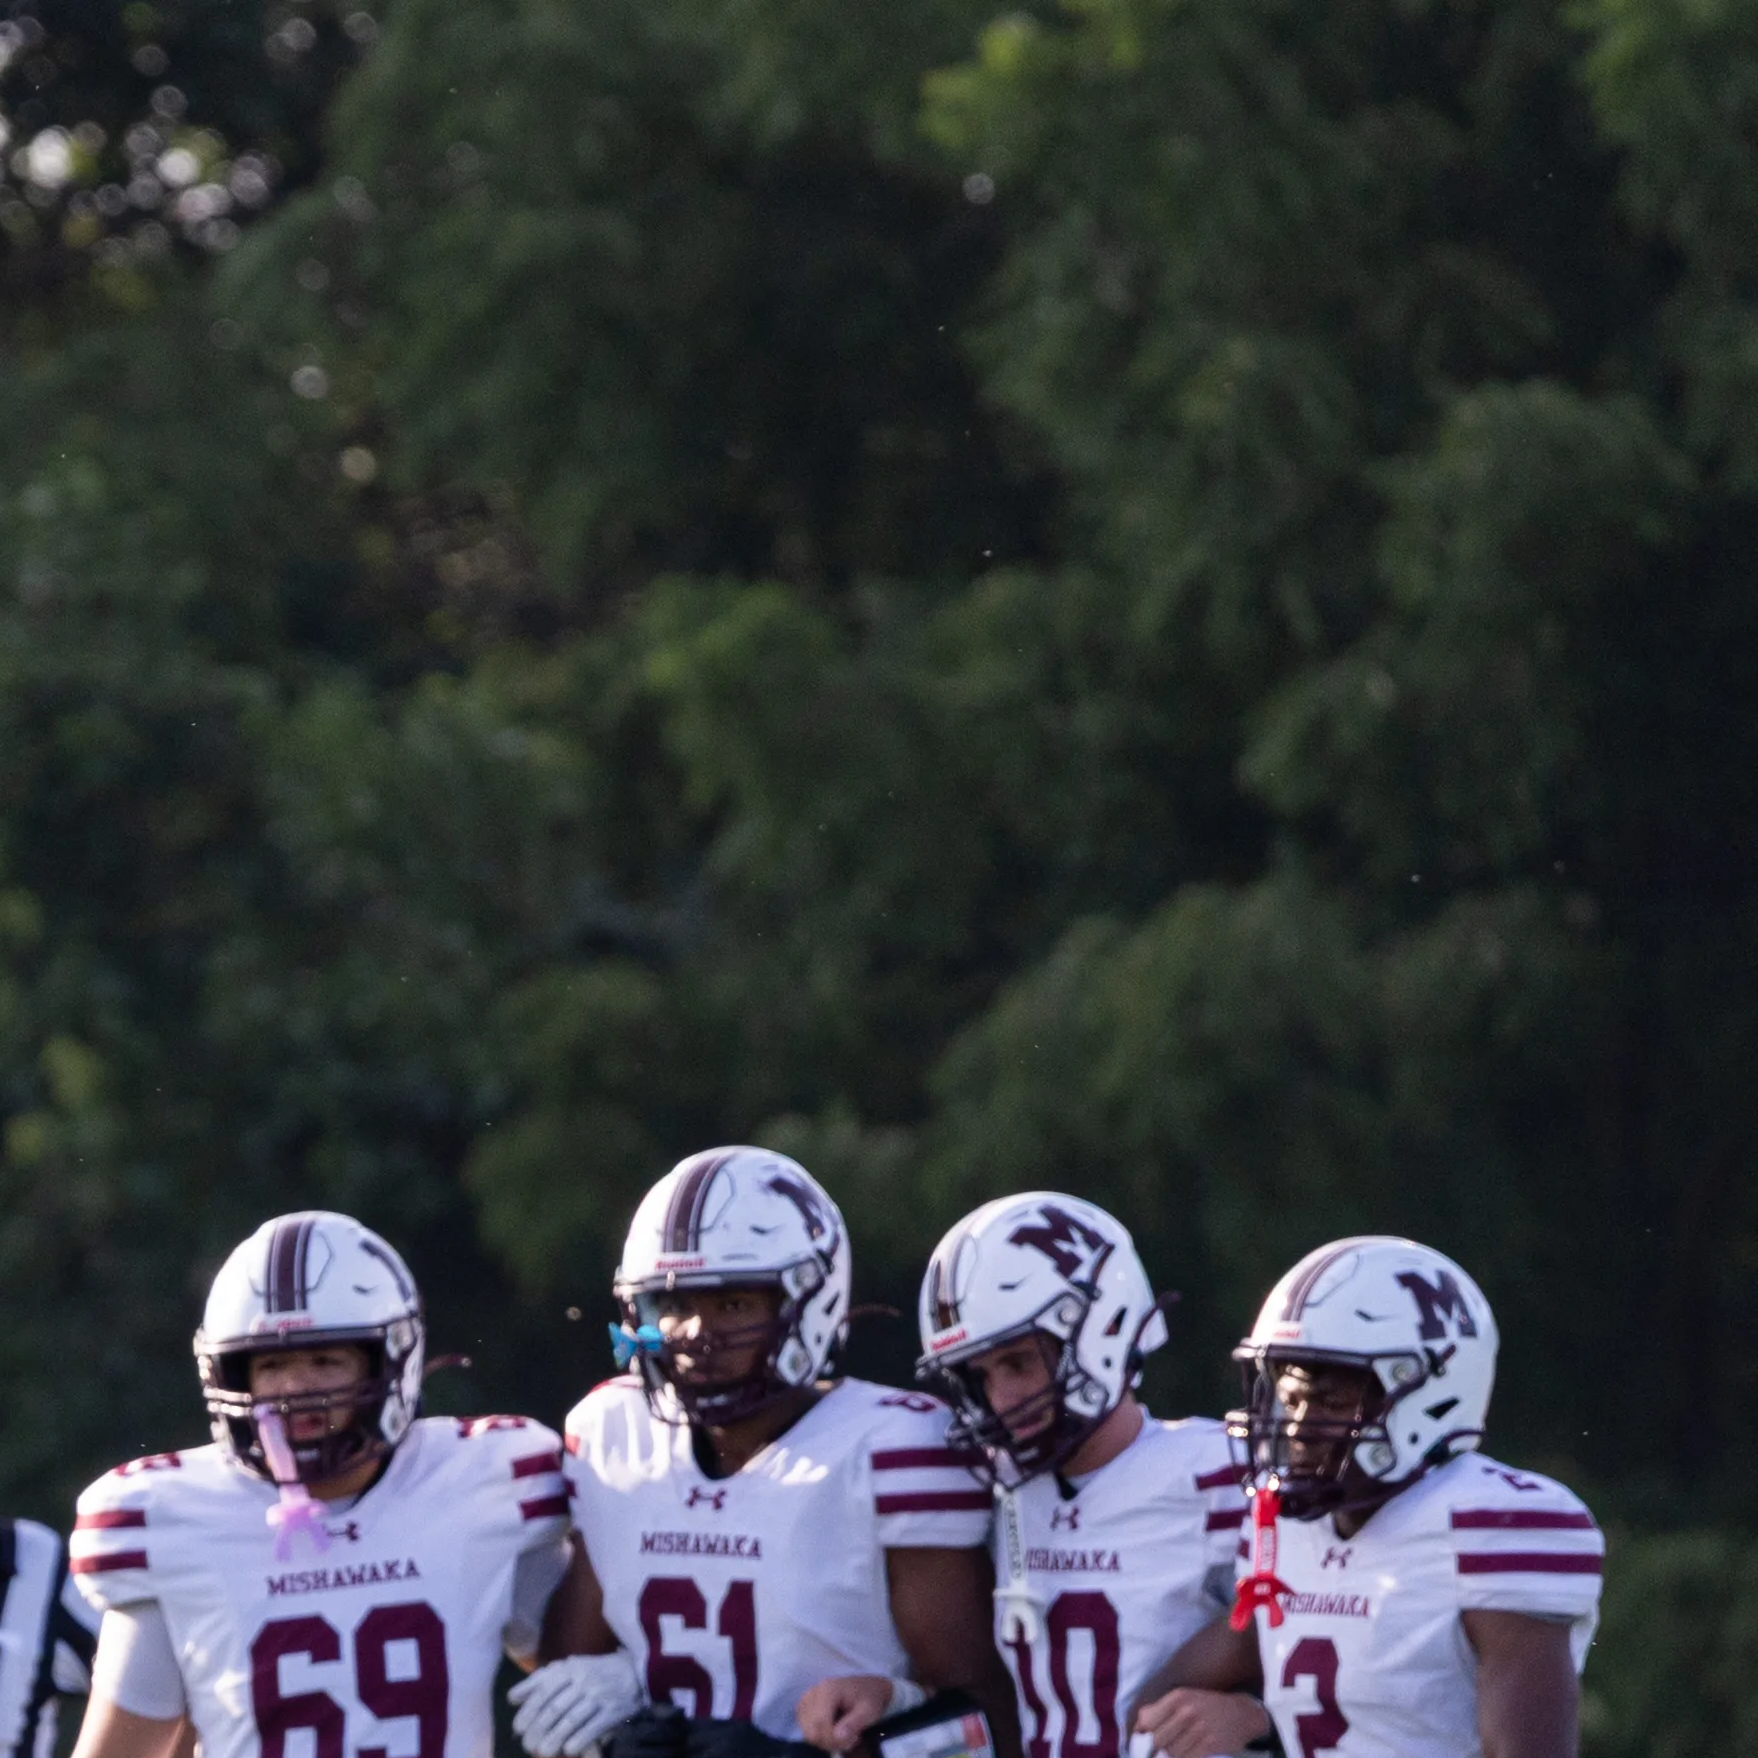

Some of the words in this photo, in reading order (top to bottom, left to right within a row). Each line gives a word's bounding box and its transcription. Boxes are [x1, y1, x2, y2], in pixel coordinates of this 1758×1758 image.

[1008, 1206, 1115, 1279] M
[1393, 1269, 1478, 1341] M
[266, 1558, 422, 1598] MISHAWAKA
[639, 1531, 763, 1560] MISHAWAKA
[638, 1577, 758, 1721] 61
